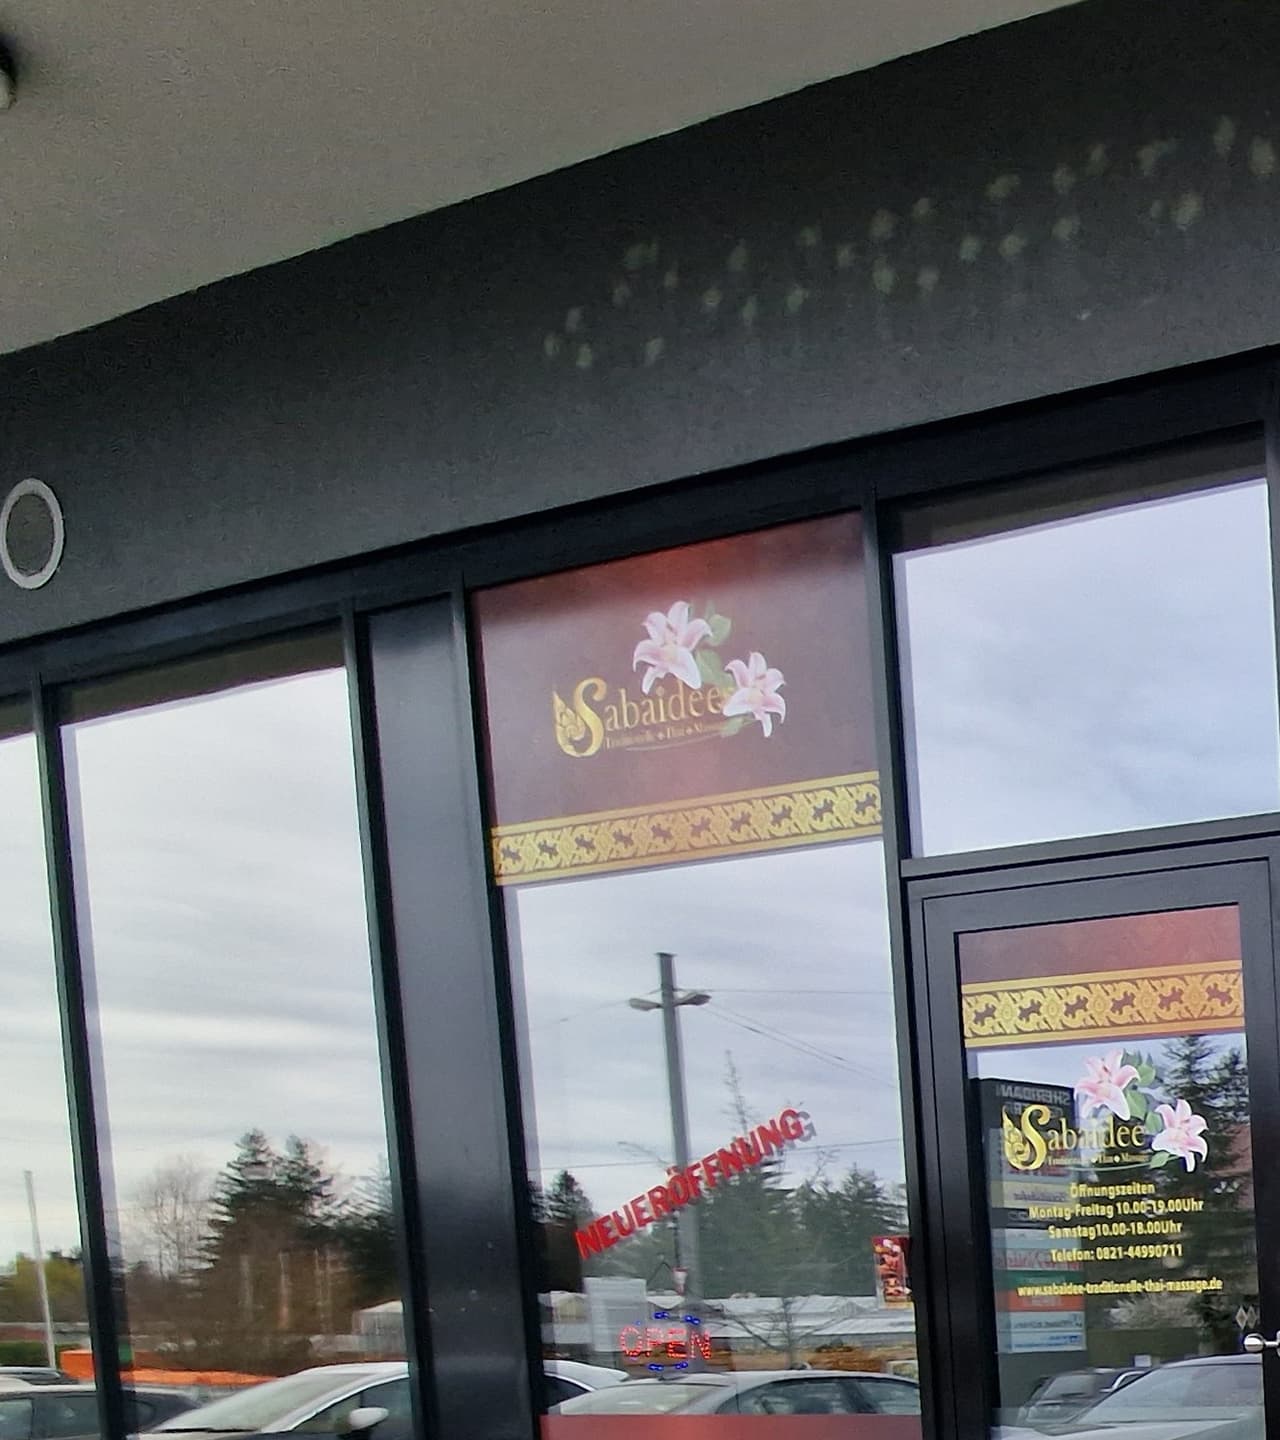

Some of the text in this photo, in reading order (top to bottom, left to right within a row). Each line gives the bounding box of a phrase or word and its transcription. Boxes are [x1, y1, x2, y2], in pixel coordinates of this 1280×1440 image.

[553, 677, 724, 757] Sabaidee
[573, 1108, 806, 1261] NEUERÖFFNUNG
[1070, 1181, 1156, 1199] Öffnungszeiten
[1028, 1202, 1114, 1220] Montag-Freitag
[1050, 1249, 1094, 1263] Telefon:
[618, 1325, 712, 1360] OPEN
